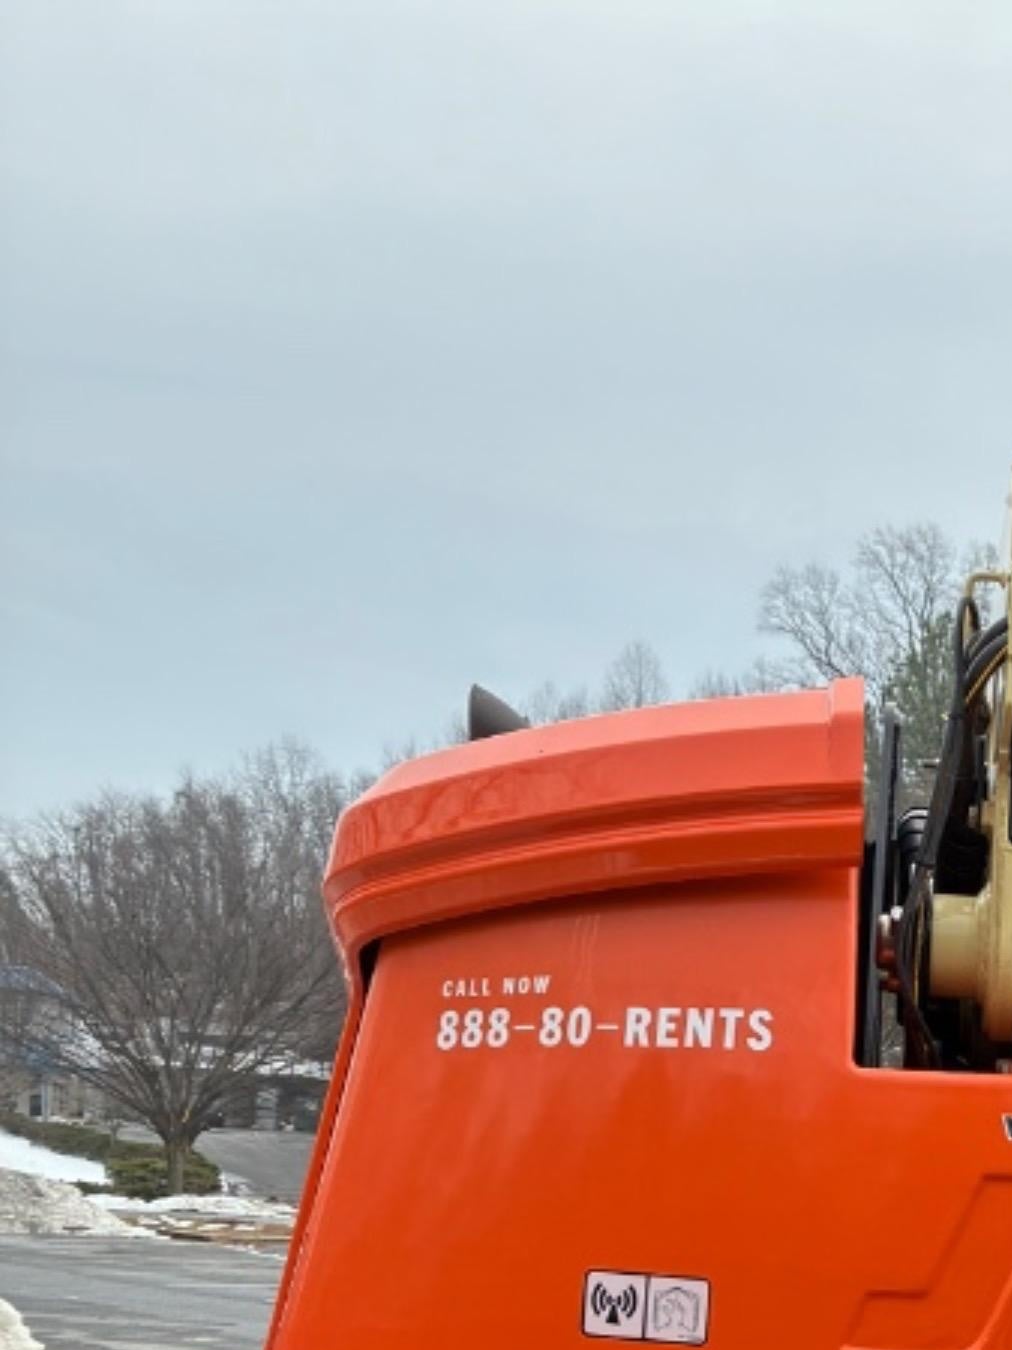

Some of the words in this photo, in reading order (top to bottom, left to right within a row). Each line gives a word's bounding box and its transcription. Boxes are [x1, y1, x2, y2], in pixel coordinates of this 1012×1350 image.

[442, 978, 491, 997] CALL
[502, 975, 552, 995] NOW
[436, 1006, 774, 1051] 888-80-RENTS
